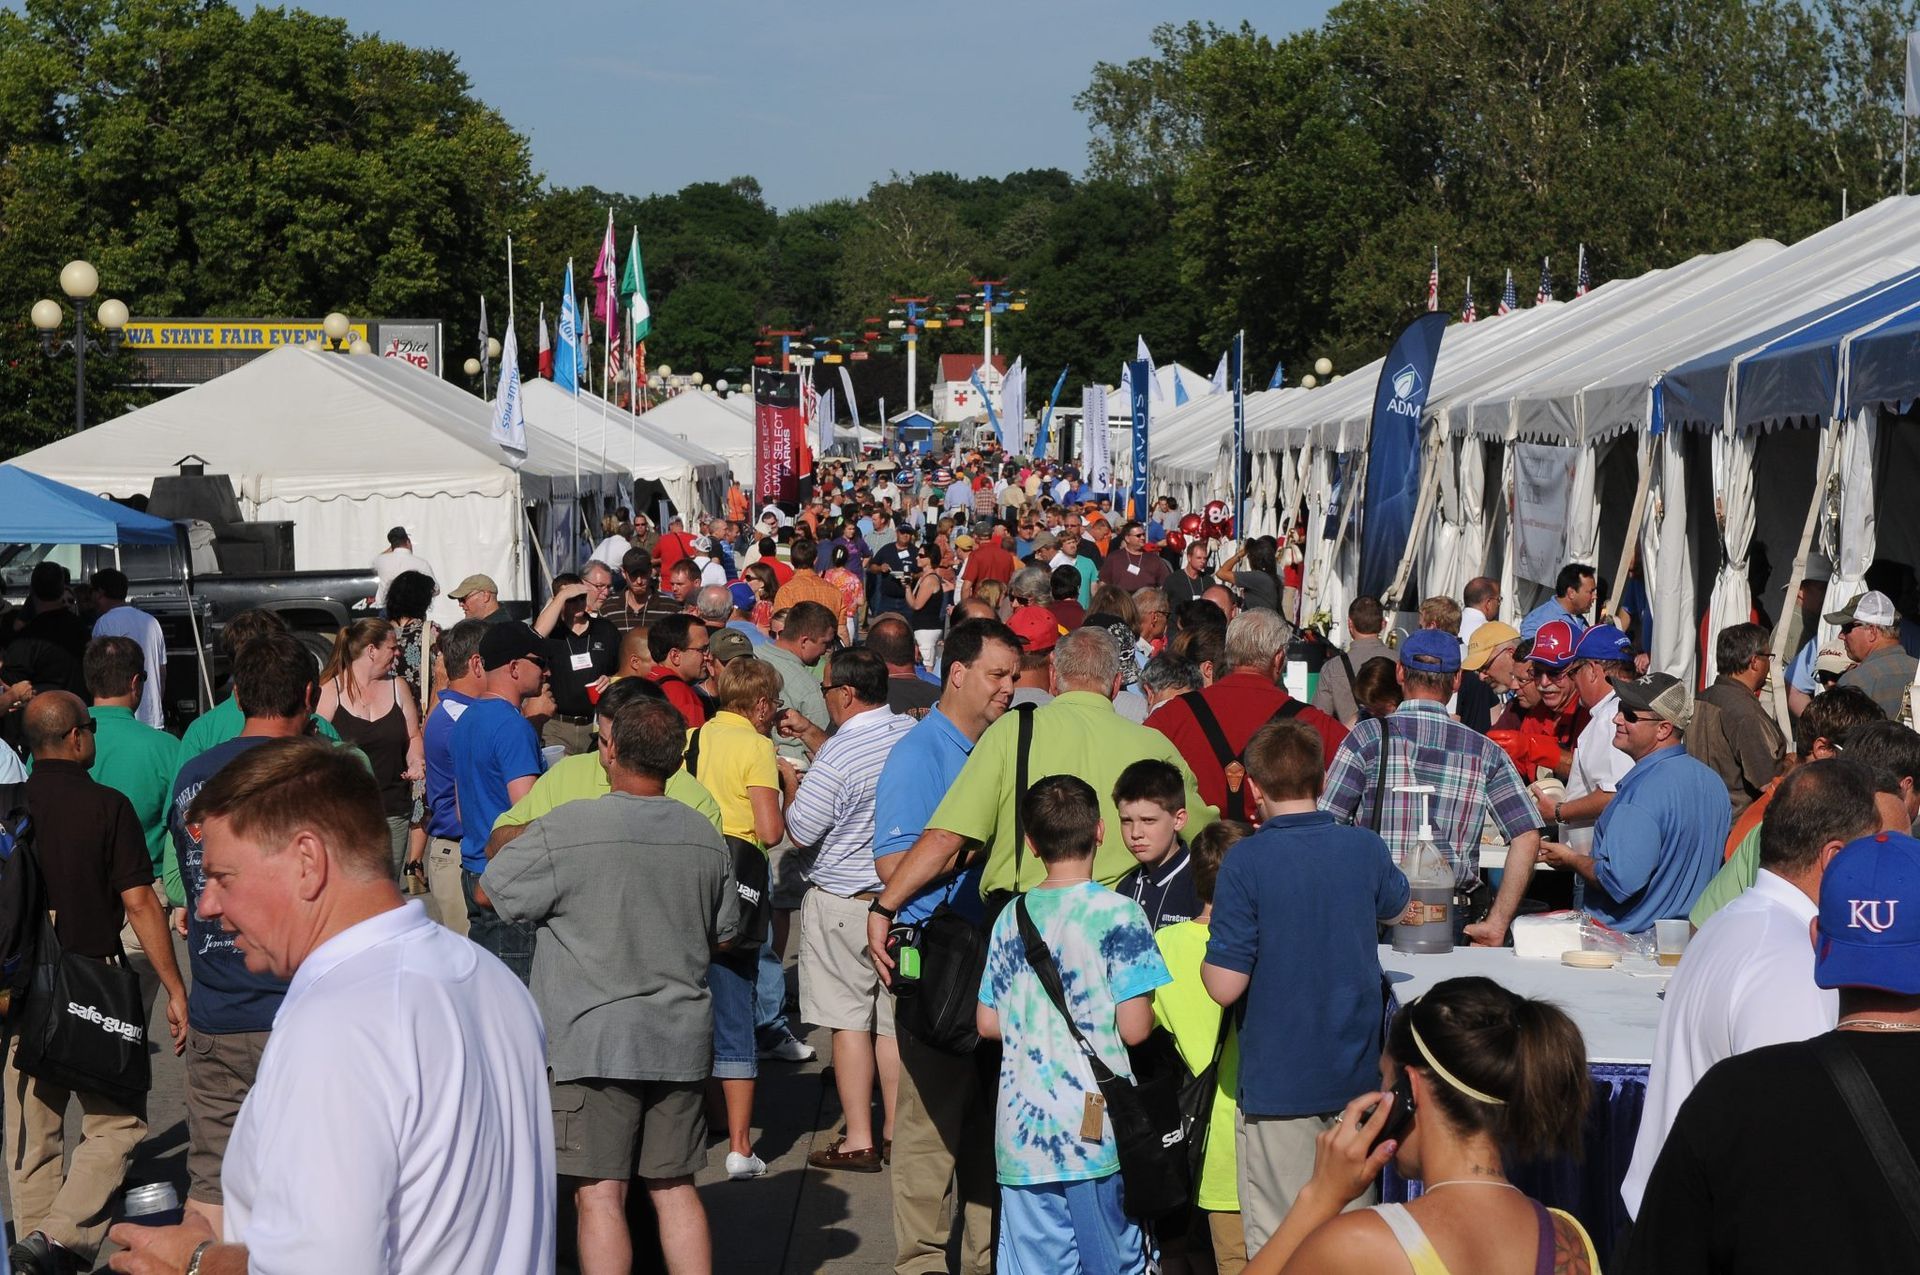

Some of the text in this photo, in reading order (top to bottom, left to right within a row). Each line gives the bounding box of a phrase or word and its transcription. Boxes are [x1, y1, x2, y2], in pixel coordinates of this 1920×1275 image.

[126, 328, 329, 345] WA STATE FAIR EVENT
[400, 339, 429, 353] Diet
[502, 403, 513, 429] PIGS
[1386, 399, 1421, 419] ADM
[774, 412, 783, 459] SELECT
[783, 428, 791, 476] FARMS
[1847, 900, 1899, 933] KU
[67, 1002, 143, 1039] safe-guard
